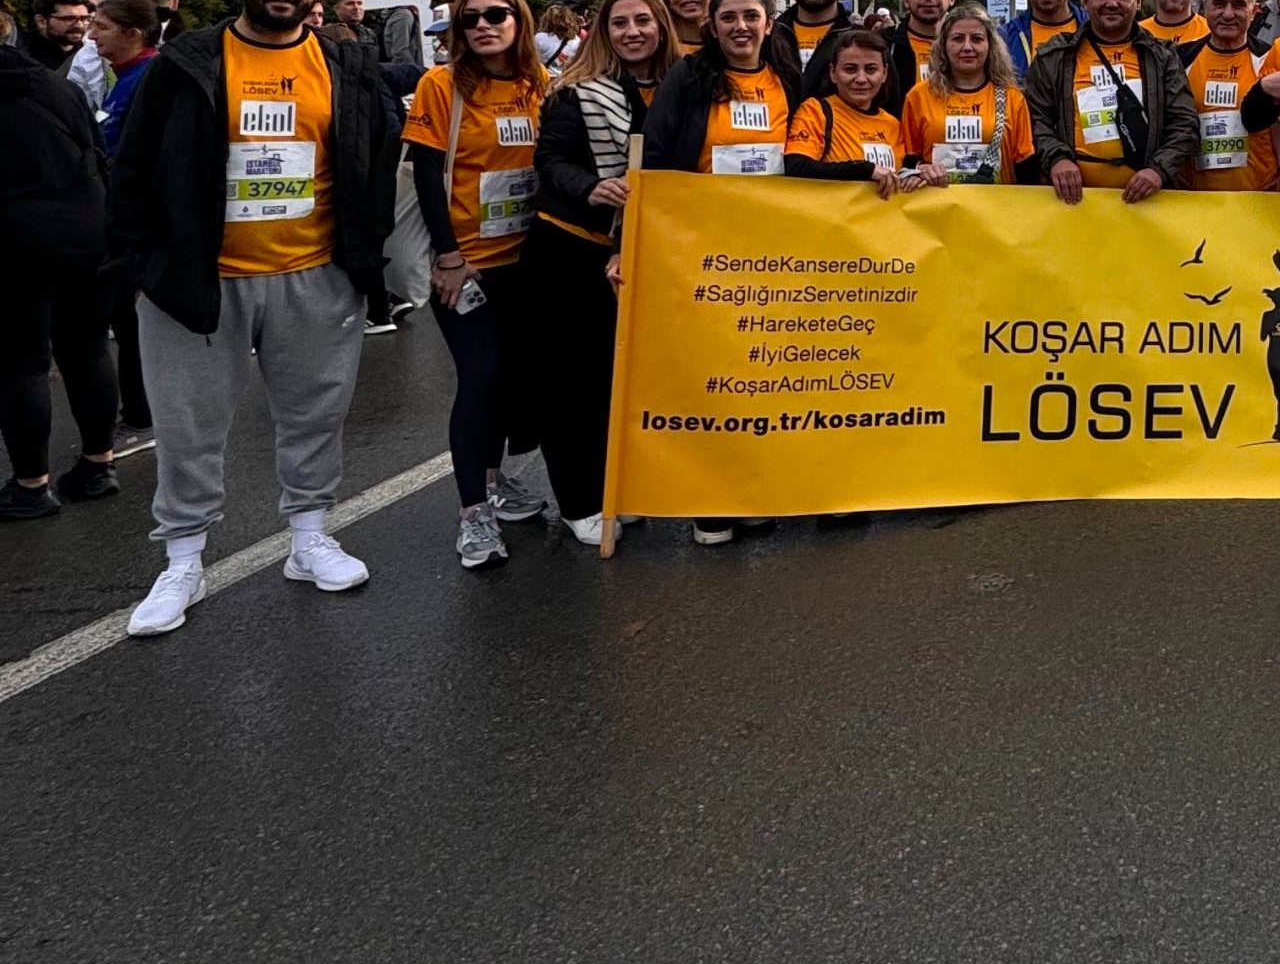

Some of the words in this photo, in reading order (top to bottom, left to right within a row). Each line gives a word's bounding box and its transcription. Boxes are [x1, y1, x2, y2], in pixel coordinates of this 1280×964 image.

[1207, 139, 1244, 152] 37990
[248, 180, 307, 197] 37947
[702, 255, 915, 274] #SendeKansereDurDe
[694, 285, 918, 306] #SağlığınızServetinizdir
[737, 315, 876, 335] #HareketeGeç
[983, 321, 1124, 362] KOŞAR
[1139, 322, 1241, 354] ADIM
[748, 342, 861, 367] #İyiGelecek
[705, 371, 895, 397] #KoşarAdımLÖSEV
[981, 371, 1236, 441] LÖSEV
[641, 407, 945, 436] losev.org.tr/kosaradim
